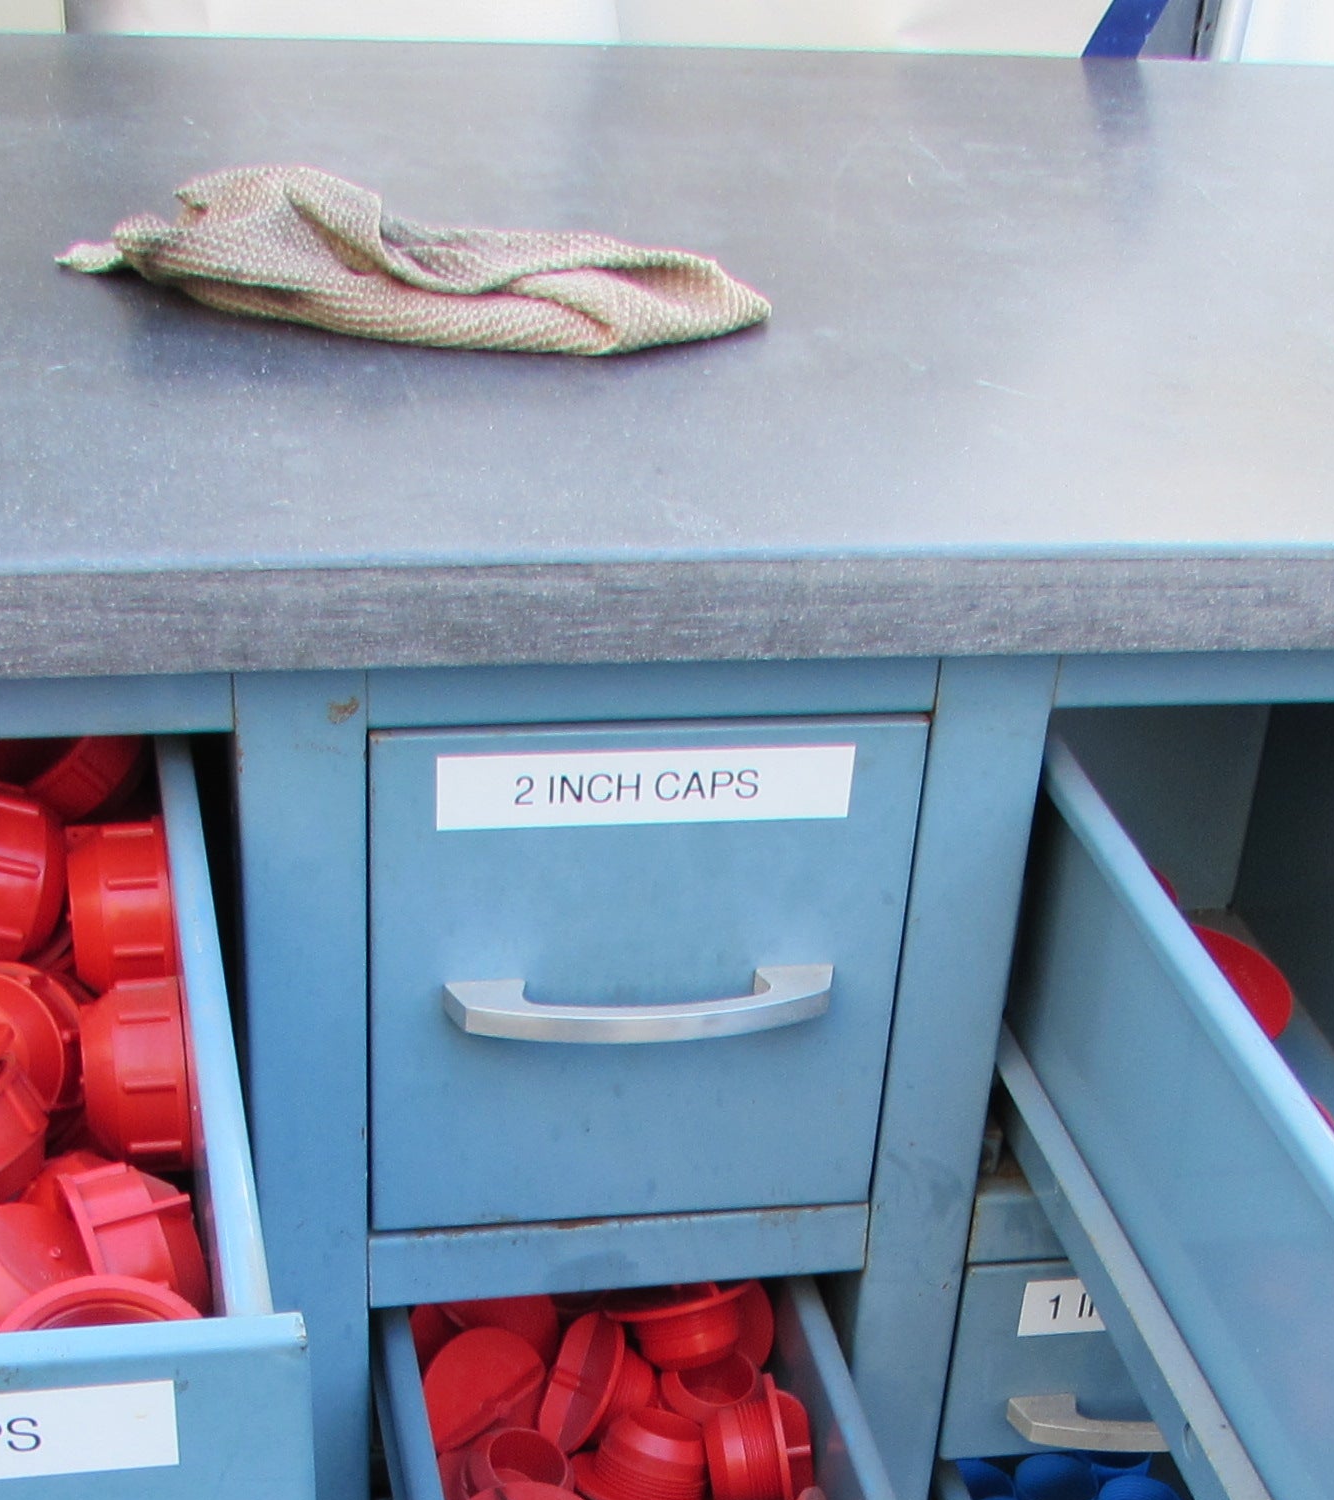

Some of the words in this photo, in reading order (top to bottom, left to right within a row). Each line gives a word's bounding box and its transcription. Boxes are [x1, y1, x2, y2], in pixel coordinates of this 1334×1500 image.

[514, 776, 534, 805] 2
[548, 773, 642, 804] INCH
[654, 769, 760, 801] CAPS
[1049, 1294, 1061, 1320] 1
